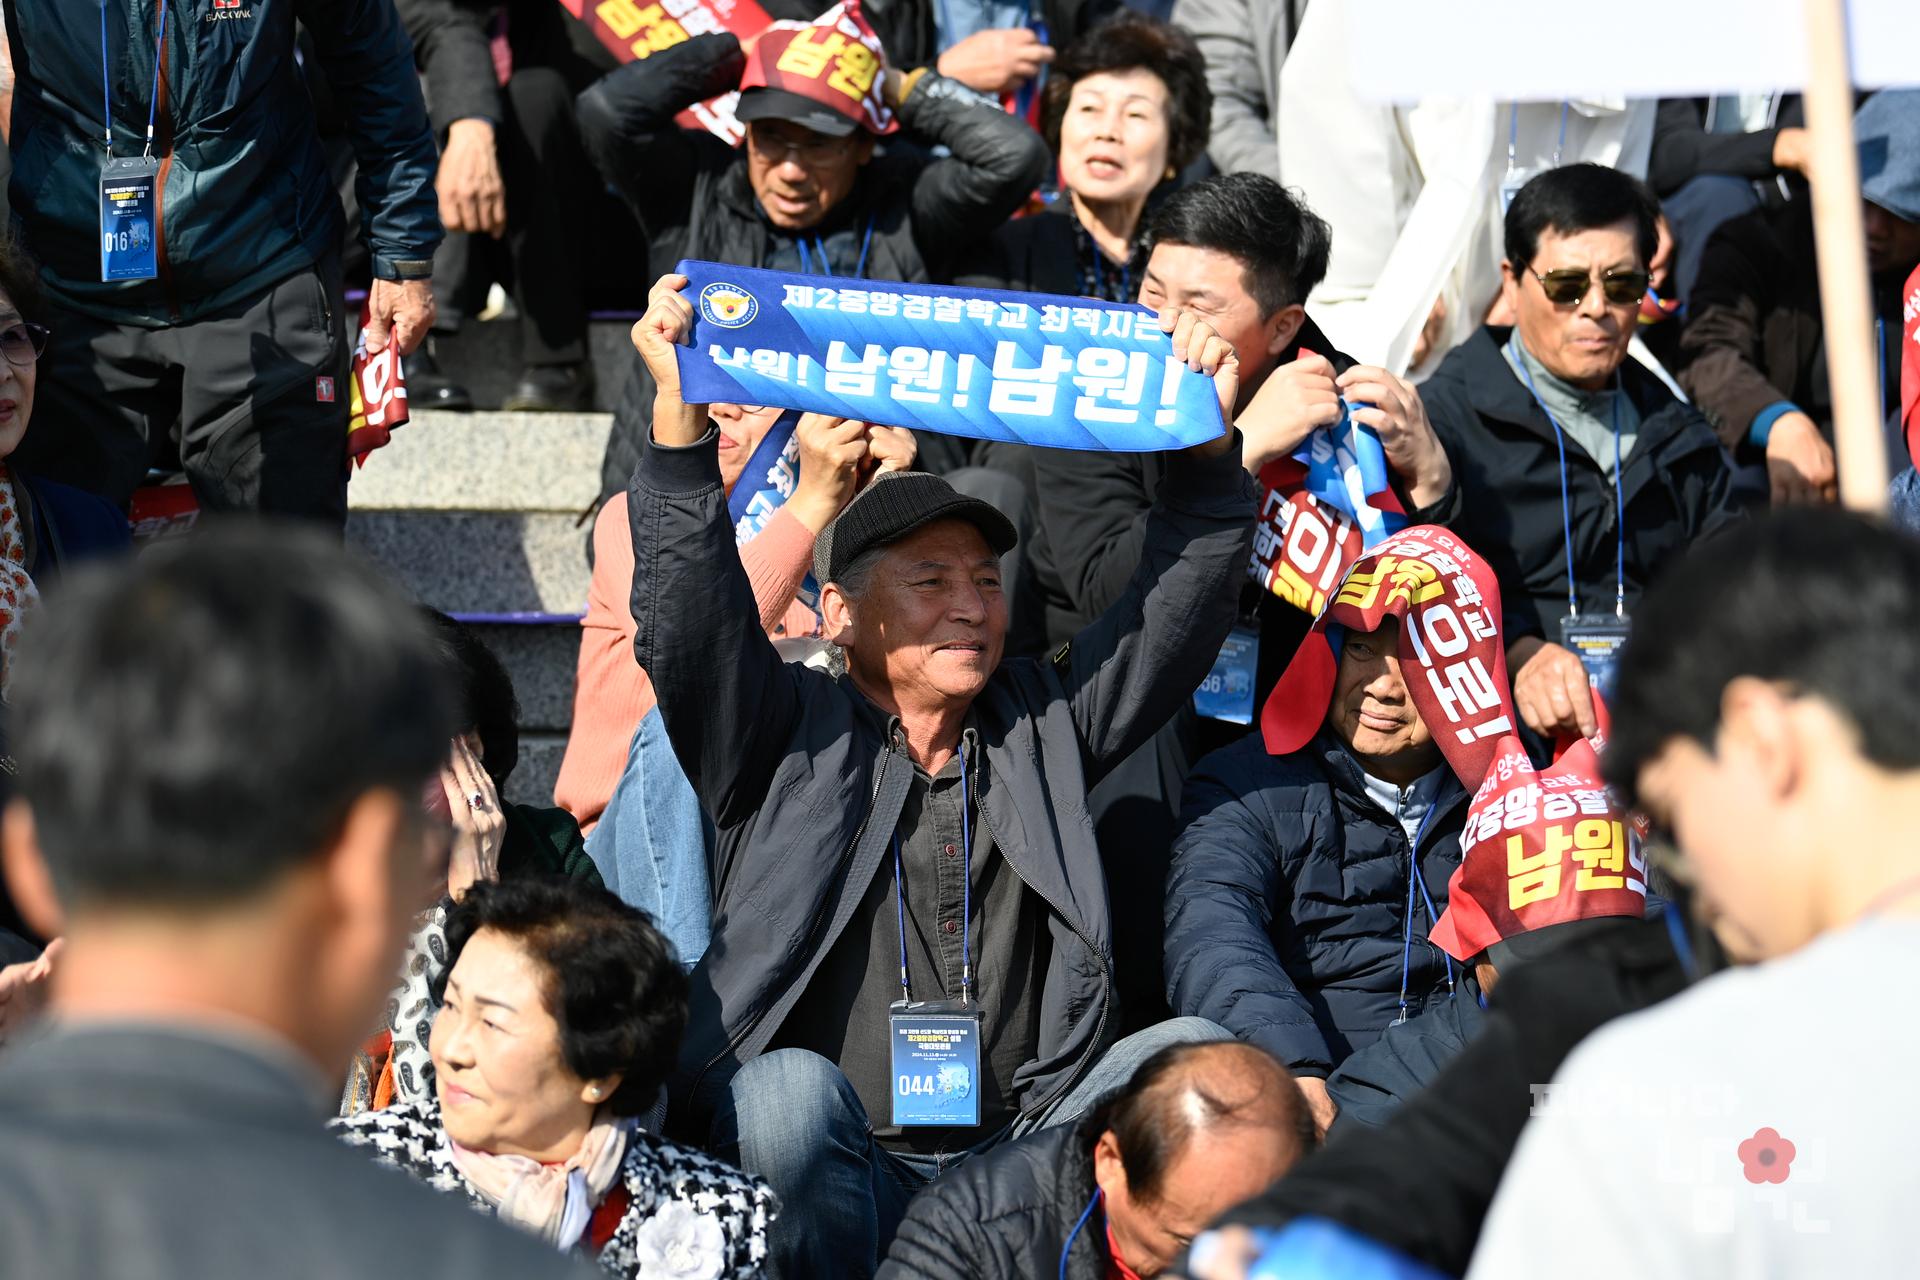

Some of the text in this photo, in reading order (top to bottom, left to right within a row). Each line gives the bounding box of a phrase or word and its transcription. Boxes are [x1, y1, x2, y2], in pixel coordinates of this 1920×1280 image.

[104, 231, 128, 253] 016
[782, 284, 1164, 341] 제2중앙경찰학교 최적지는
[825, 340, 975, 408] 남원!
[988, 341, 1184, 426] 남원!
[898, 1075, 935, 1096] 044
